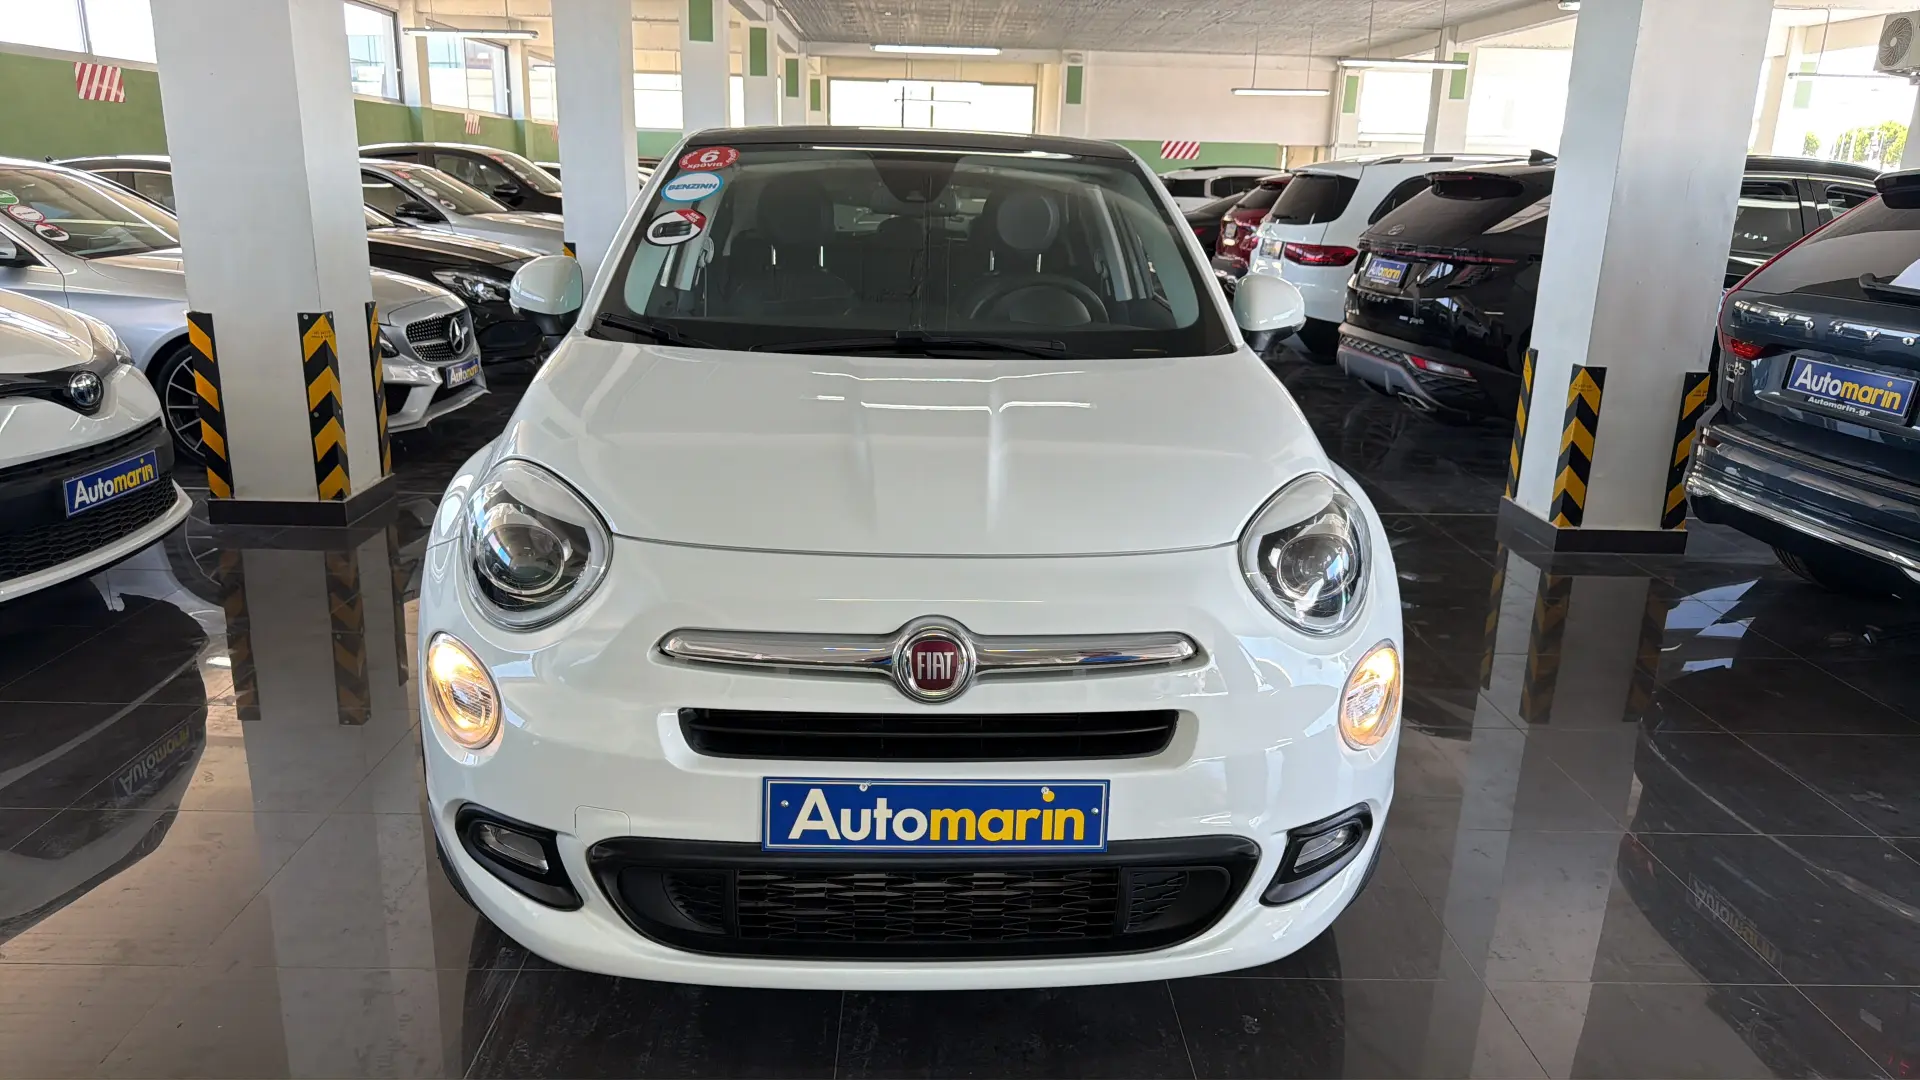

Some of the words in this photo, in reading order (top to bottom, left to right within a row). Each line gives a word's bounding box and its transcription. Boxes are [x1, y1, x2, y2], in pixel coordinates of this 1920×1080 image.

[700, 151, 720, 163] 6
[1794, 363, 1902, 410] Automarin
[1807, 396, 1871, 416] Automarin.gr
[74, 458, 154, 509] Automarin
[917, 652, 954, 680] FIAT
[788, 788, 1085, 841] Automarin
